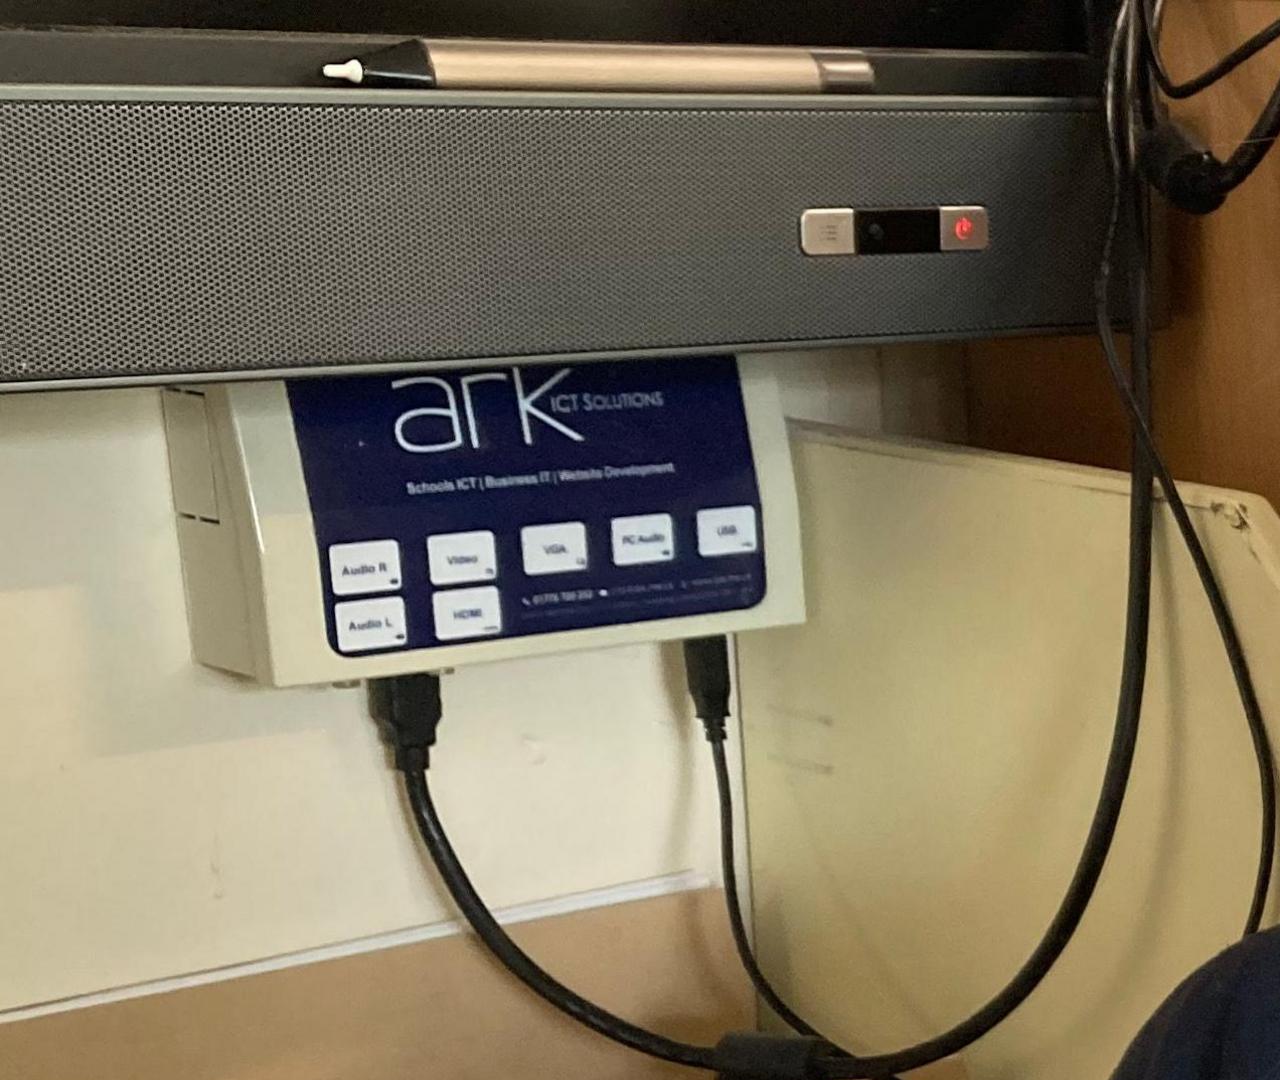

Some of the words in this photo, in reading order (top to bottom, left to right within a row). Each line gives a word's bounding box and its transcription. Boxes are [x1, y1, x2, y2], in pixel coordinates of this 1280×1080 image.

[391, 367, 585, 453] ark
[550, 394, 578, 412] ICT
[406, 482, 455, 495] Schools
[456, 477, 477, 490] ICT
[446, 555, 478, 566] Video
[342, 563, 376, 577] Audio
[378, 562, 387, 573] R
[349, 619, 382, 631] Audio
[385, 617, 393, 628] L
